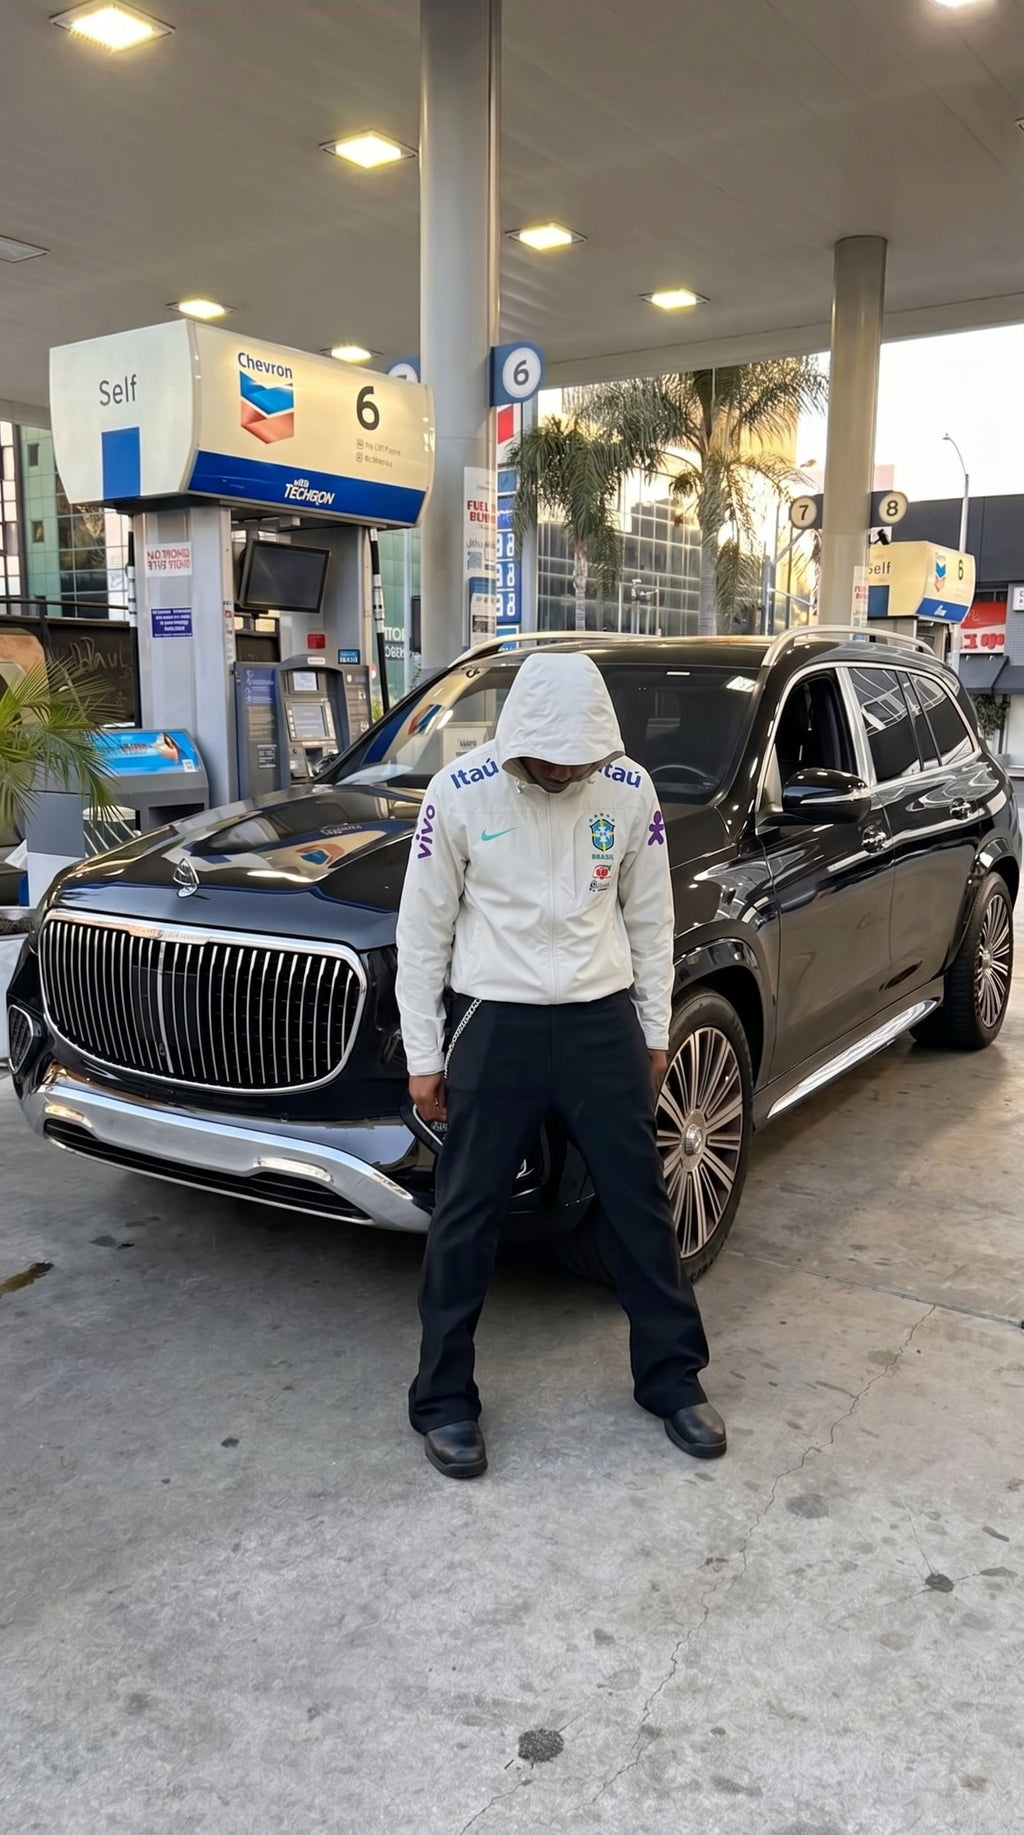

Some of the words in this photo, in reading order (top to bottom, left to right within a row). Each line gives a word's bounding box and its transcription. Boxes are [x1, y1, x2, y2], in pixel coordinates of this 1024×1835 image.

[238, 352, 293, 379] Chevron
[513, 360, 530, 386] 6
[100, 374, 137, 407] Self
[356, 386, 380, 431] 6
[467, 500, 489, 512] FUEL
[799, 505, 809, 521] 7
[886, 500, 899, 517] 8
[958, 559, 964, 580] 6
[450, 758, 499, 789] Itaú
[598, 763, 642, 788] taú
[416, 805, 435, 859] vivo
